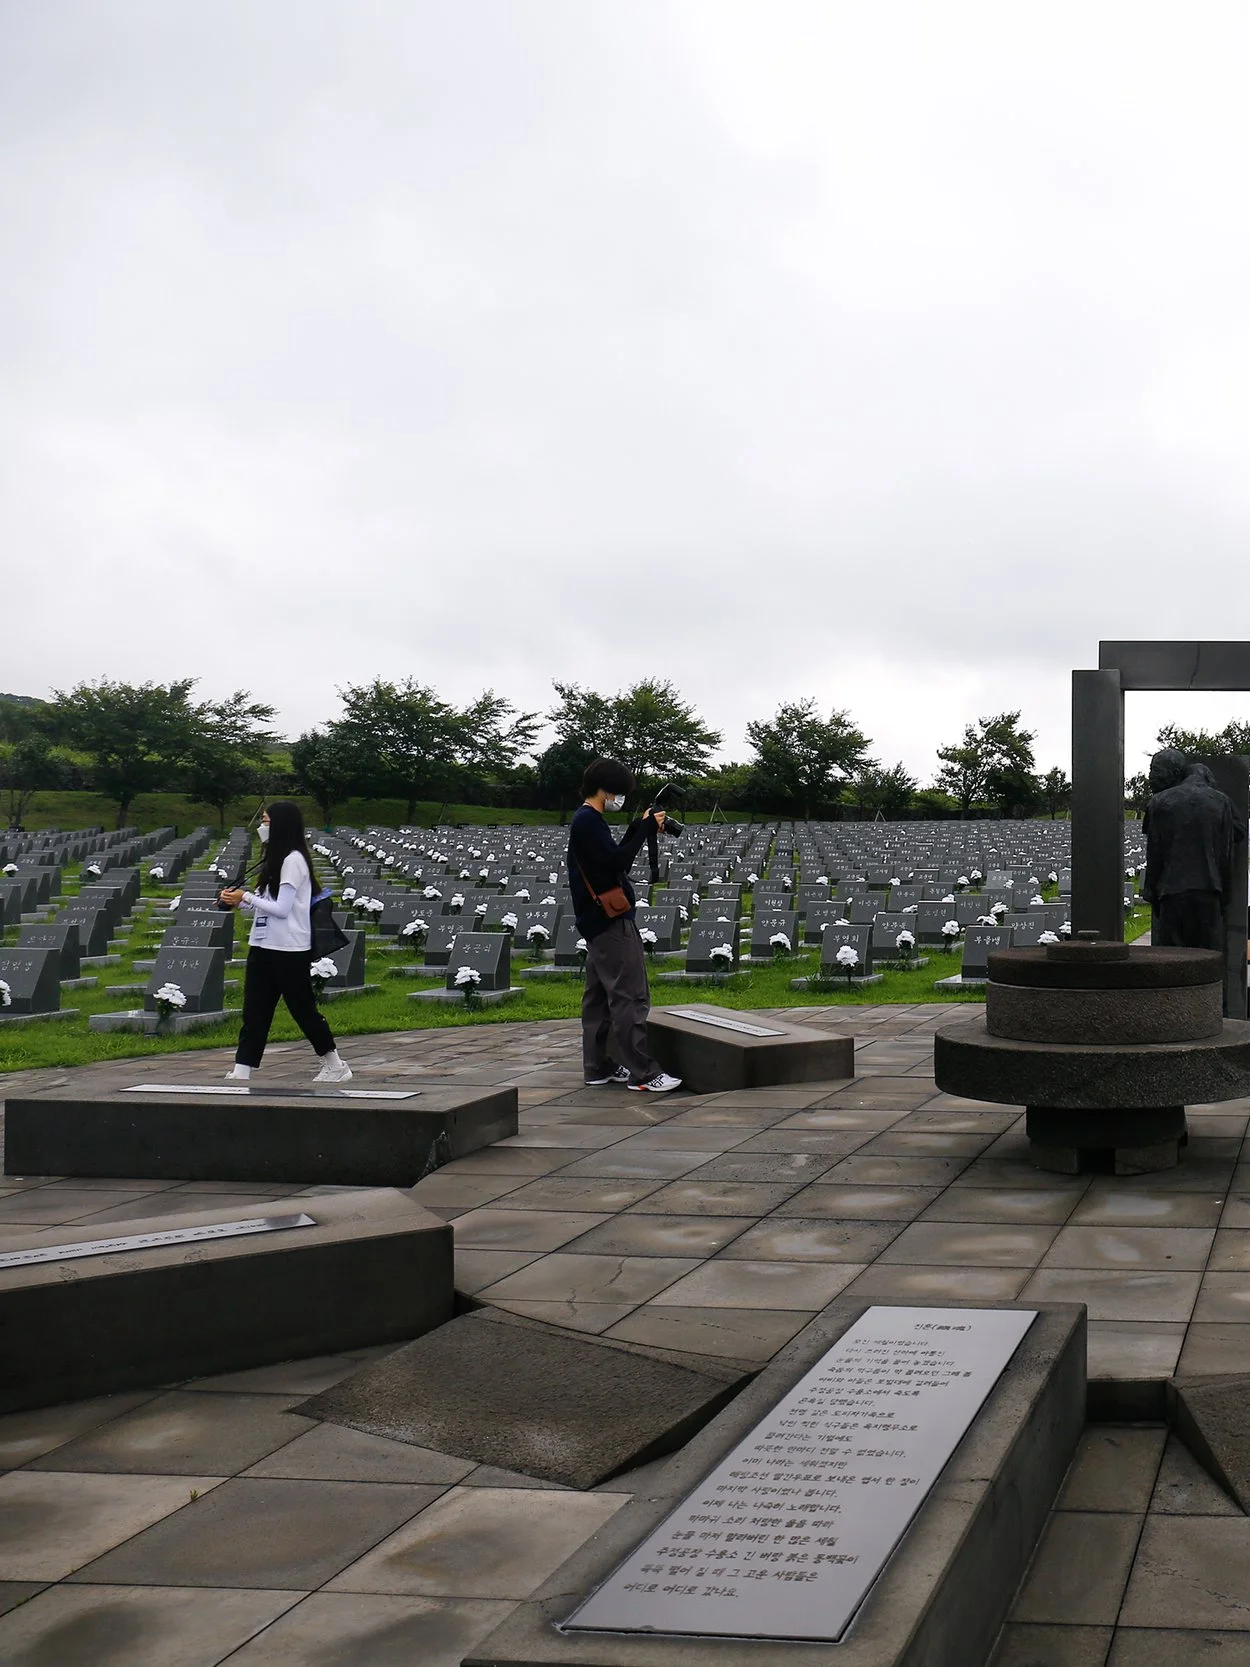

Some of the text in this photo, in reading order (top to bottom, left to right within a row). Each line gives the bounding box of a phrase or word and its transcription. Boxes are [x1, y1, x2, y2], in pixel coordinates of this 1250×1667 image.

[741, 1457, 763, 1465] 이미
[885, 1476, 896, 1486] 한
[715, 1484, 748, 1493] 마지막
[701, 1499, 726, 1508] 이제
[727, 1500, 748, 1510] 나는
[721, 1516, 747, 1525] 소리
[671, 1530, 696, 1540] 눈물
[772, 1534, 785, 1545] 한
[656, 1546, 703, 1559] 주정공장
[704, 1548, 738, 1560] 수용소
[743, 1551, 757, 1561] 긴
[726, 1568, 741, 1577] 그
[742, 1569, 768, 1580] 고운
[623, 1582, 659, 1593] 어디로
[662, 1584, 698, 1595] 어디로
